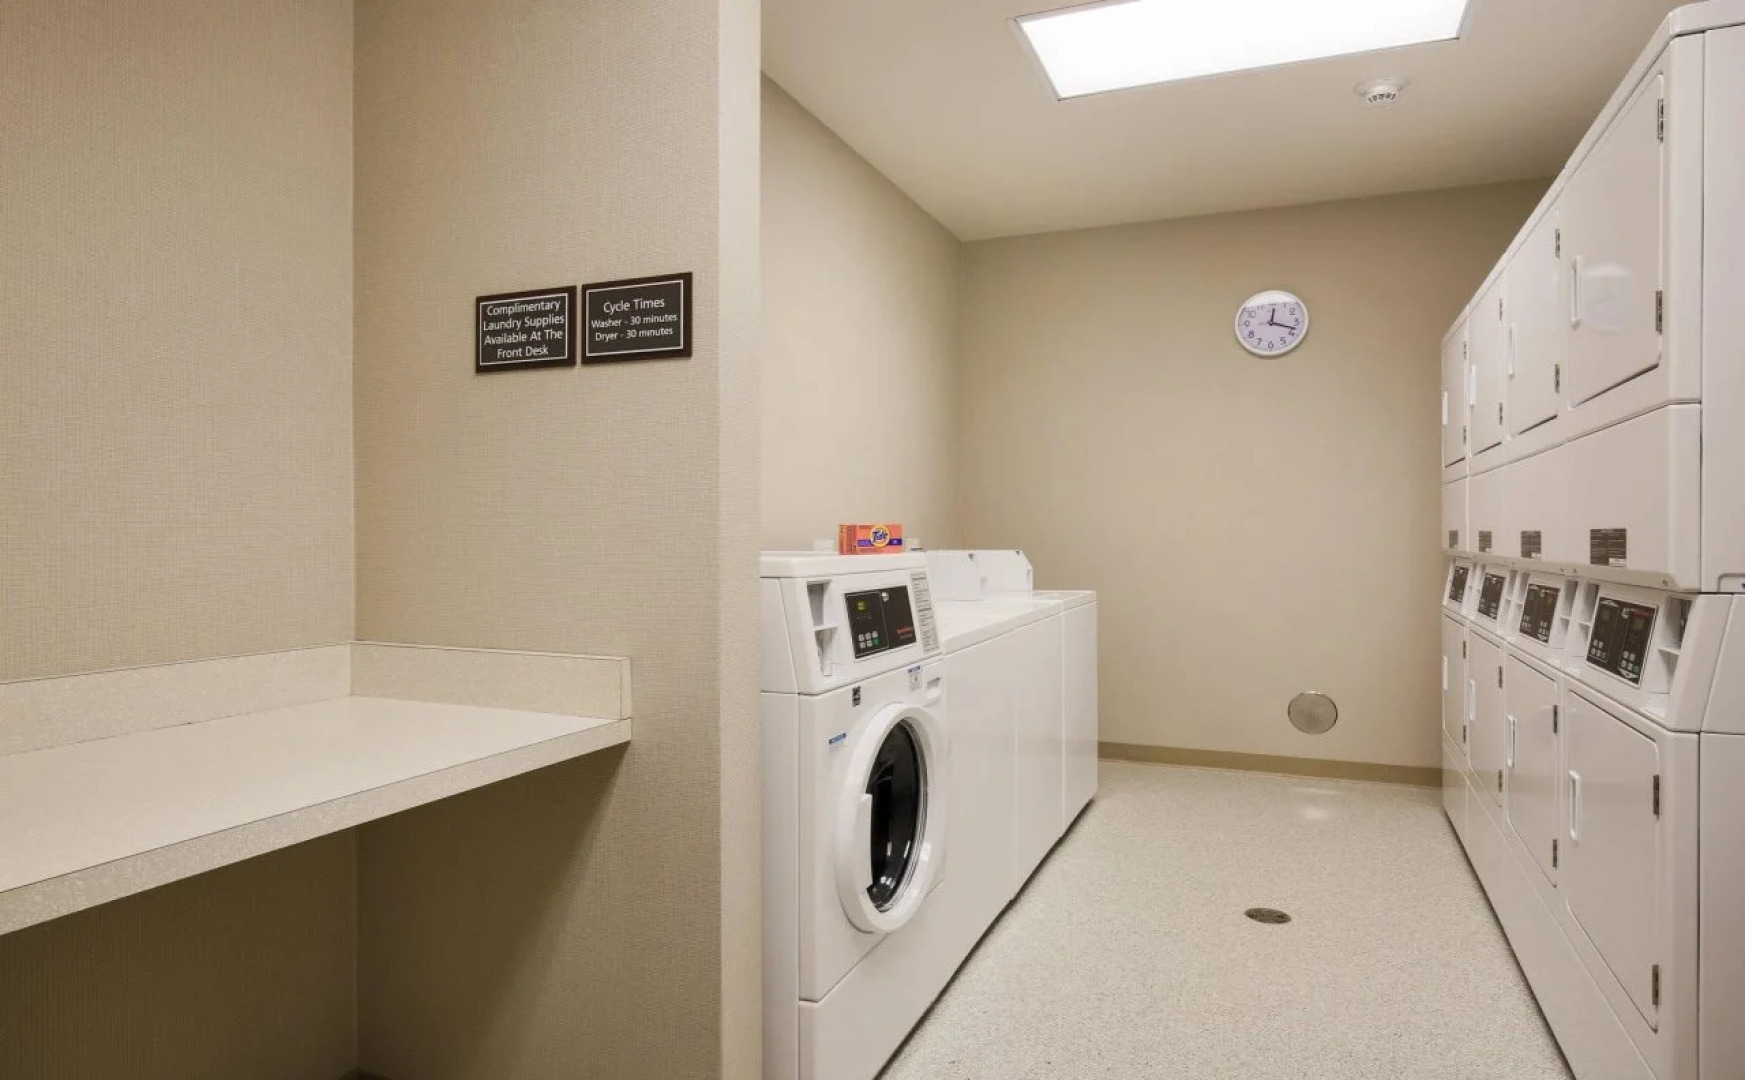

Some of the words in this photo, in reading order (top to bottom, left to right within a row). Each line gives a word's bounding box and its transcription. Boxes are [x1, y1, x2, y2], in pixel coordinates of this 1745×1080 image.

[486, 300, 561, 316] Complimentary
[603, 300, 630, 315] Cycle
[633, 298, 665, 310] Times
[483, 317, 521, 330] Laundry
[524, 313, 565, 328] Supplies
[591, 318, 622, 328] Washer
[630, 315, 641, 325] 30
[642, 314, 677, 324] minutes
[484, 331, 527, 345] Available
[530, 330, 542, 341] At
[544, 328, 563, 339] The
[595, 332, 619, 342] Dryer
[626, 329, 637, 339] 30
[638, 327, 673, 338] minutes
[1249, 330, 1255, 338] 8
[497, 347, 523, 359] Front
[525, 344, 549, 357] Desk
[1268, 341, 1274, 349] 6
